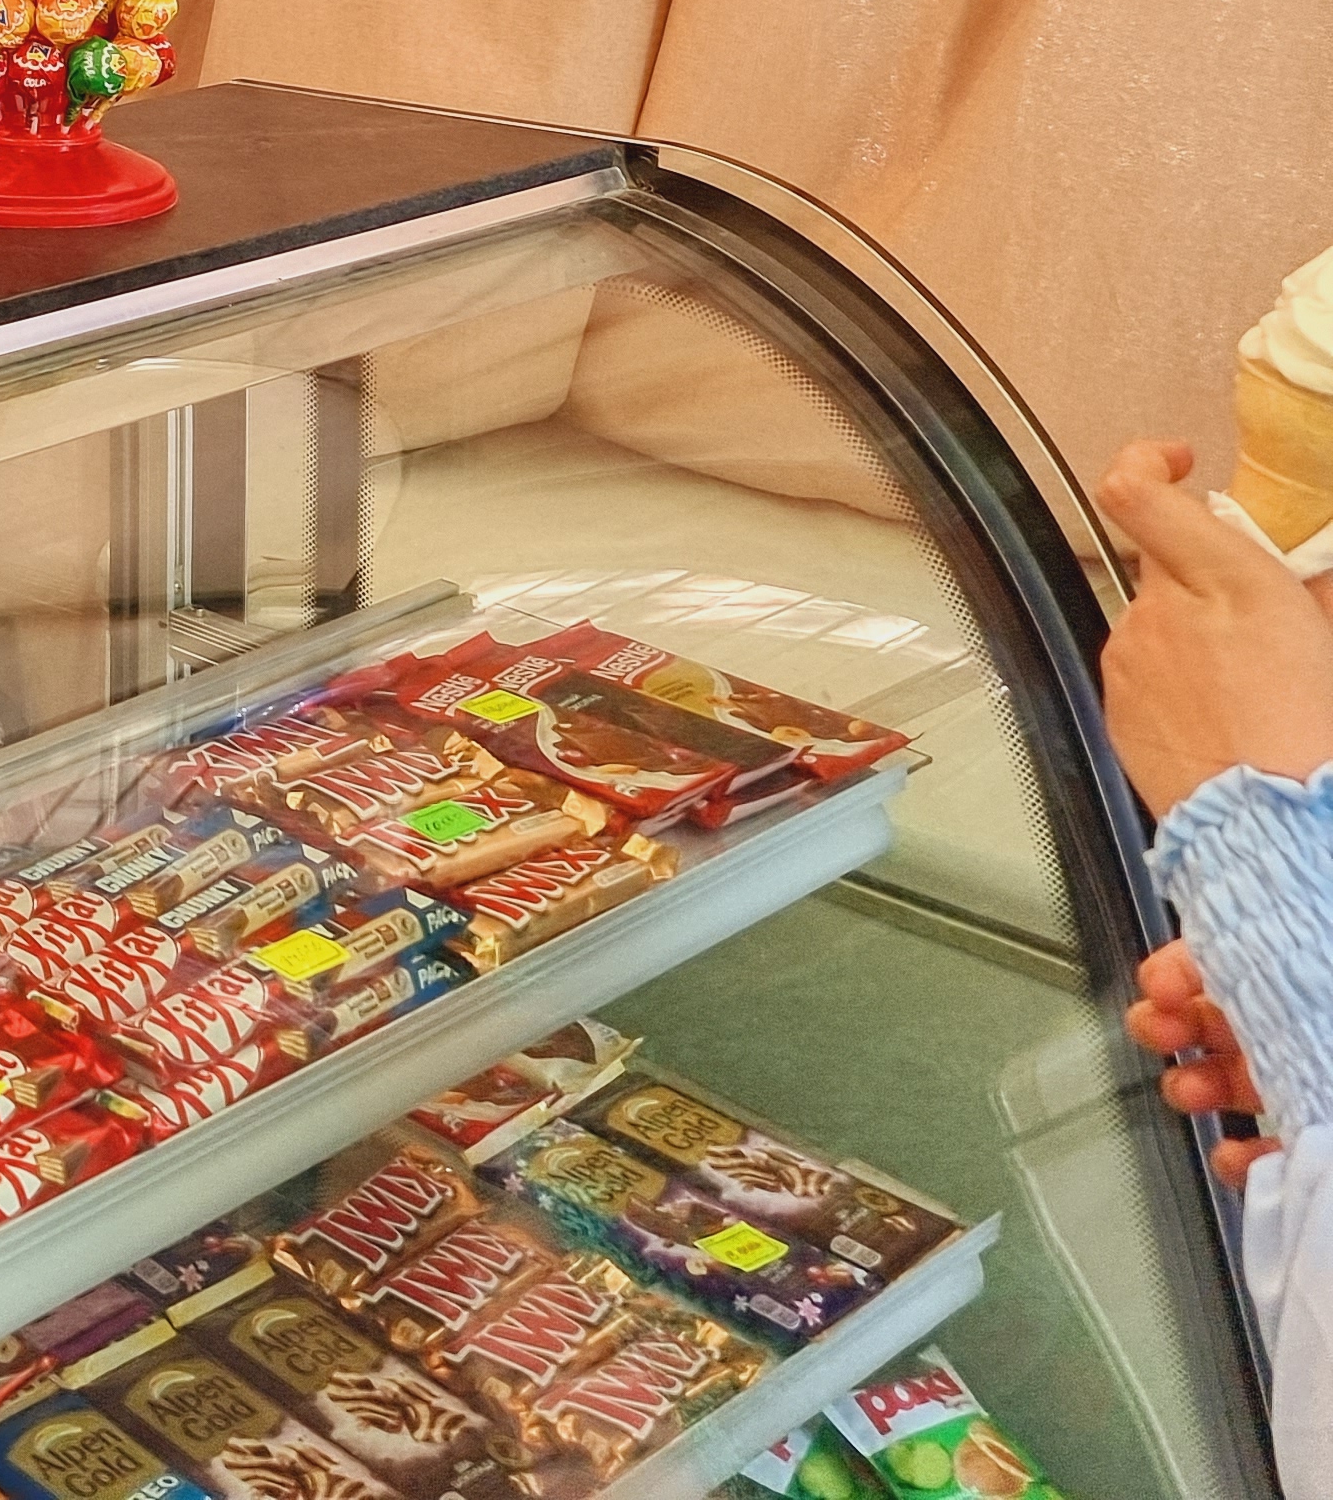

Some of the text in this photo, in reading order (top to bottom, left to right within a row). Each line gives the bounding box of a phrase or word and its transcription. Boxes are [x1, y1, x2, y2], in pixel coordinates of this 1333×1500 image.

[18, 838, 98, 882] CHUNKY
[95, 846, 176, 894] CHUNKY
[156, 879, 242, 929] CHUNKY
[464, 848, 612, 930] TWIX
[5, 892, 116, 986] KitKat
[64, 926, 177, 1024] KitKat
[142, 967, 266, 1064] KitKat
[637, 1098, 694, 1141] Alpen
[662, 1116, 721, 1151] Gold
[288, 1156, 454, 1272] TWIX
[247, 1308, 337, 1358] Alpen
[286, 1333, 361, 1379] Gold
[442, 1272, 623, 1387] TWIX
[145, 1370, 237, 1430] Alpen
[534, 1321, 721, 1441] TWIX
[180, 1397, 258, 1443] Gold
[31, 1424, 125, 1483] Alpen
[63, 1445, 139, 1498] Gold
